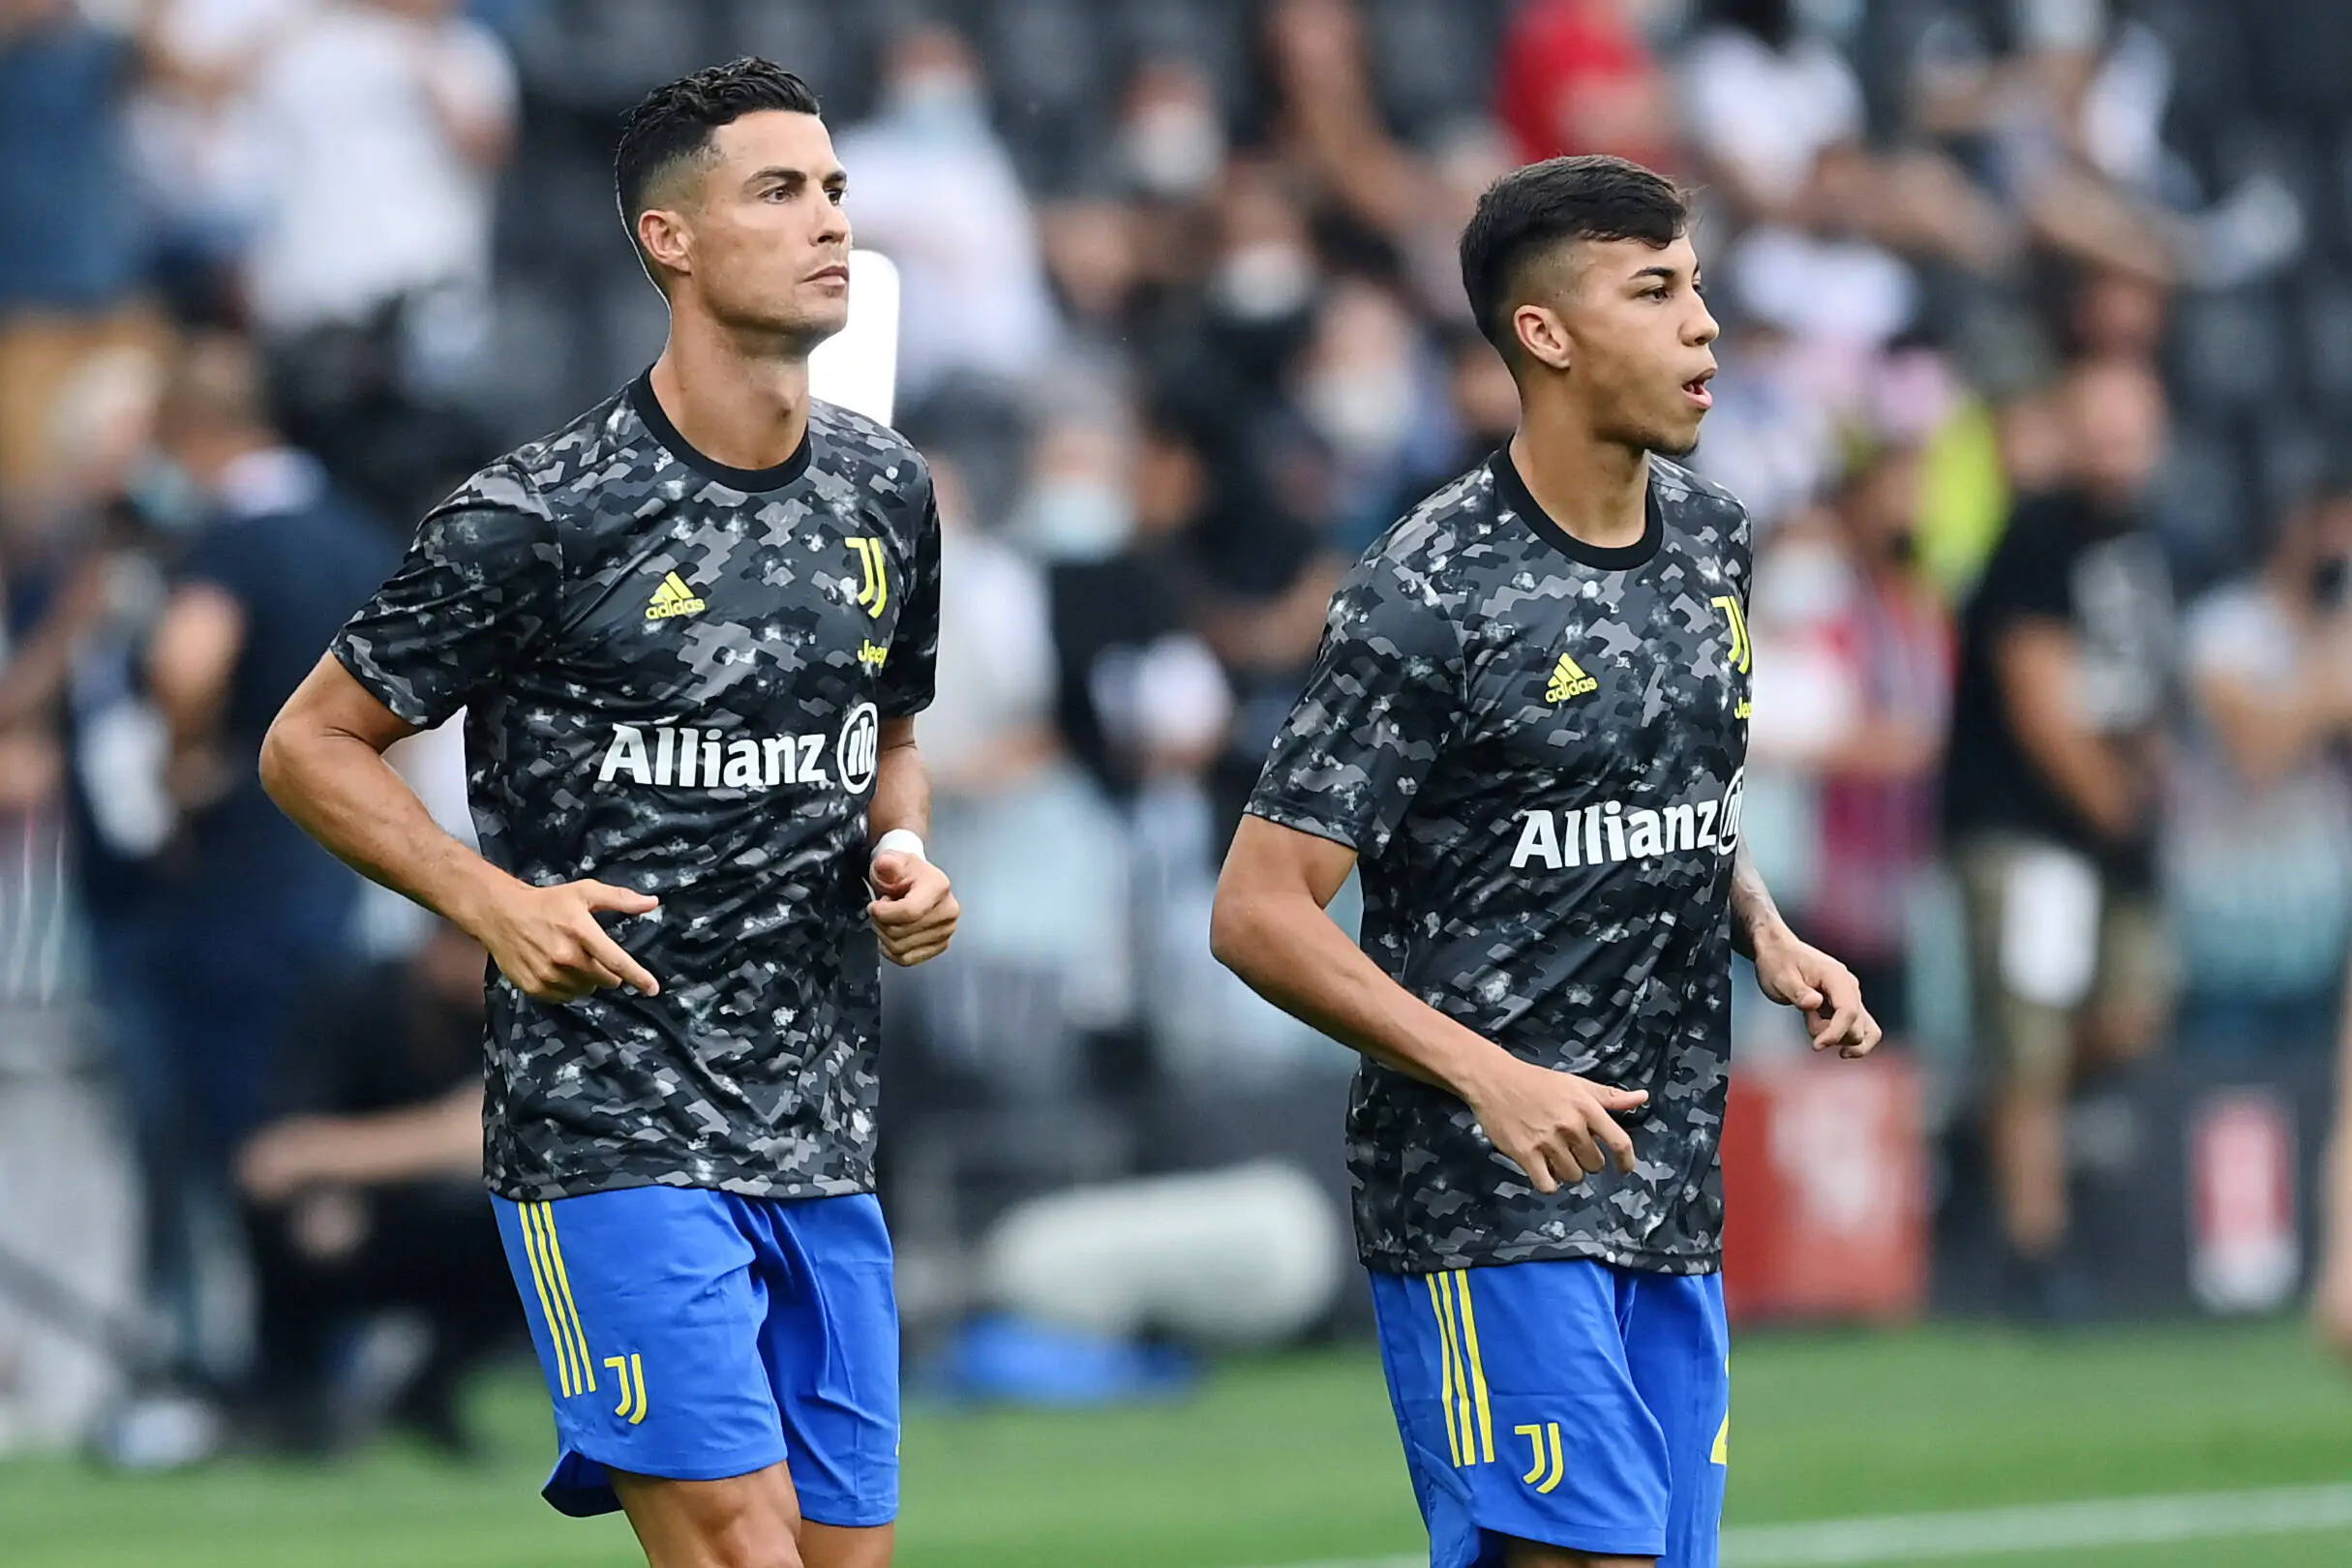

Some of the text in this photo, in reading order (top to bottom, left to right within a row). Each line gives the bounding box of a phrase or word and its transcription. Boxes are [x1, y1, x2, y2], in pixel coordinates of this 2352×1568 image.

[645, 596, 706, 620] adidas
[1545, 675, 1598, 704] adidas
[598, 723, 827, 788] Allianz
[1509, 799, 1719, 870] Allianz
